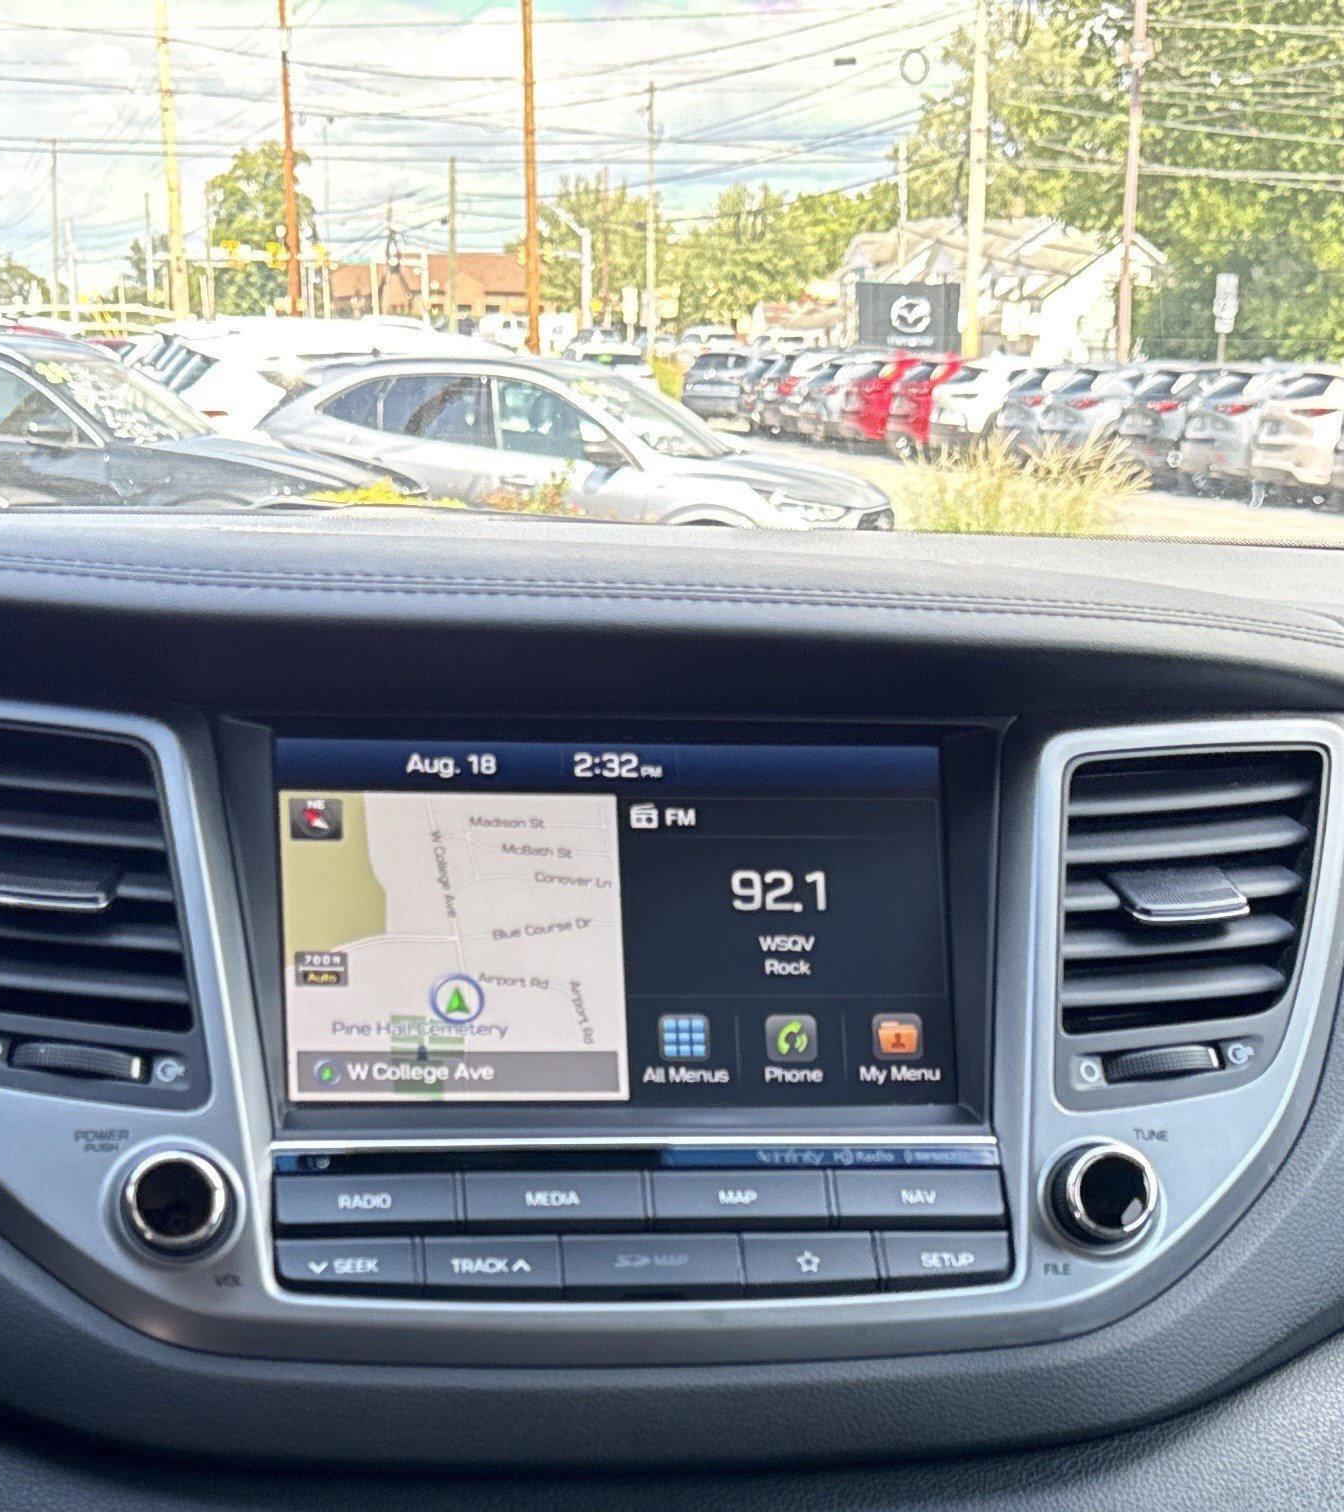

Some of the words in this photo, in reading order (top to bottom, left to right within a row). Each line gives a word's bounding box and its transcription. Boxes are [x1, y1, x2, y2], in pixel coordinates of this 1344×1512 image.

[406, 753, 460, 778] Aug.
[468, 754, 496, 773] 18
[573, 752, 639, 778] 2:32
[470, 816, 527, 829] Madison
[530, 816, 545, 829] St
[665, 808, 696, 827] FM
[557, 845, 573, 859] St
[433, 846, 451, 891] College
[444, 894, 457, 919] Ave
[731, 869, 827, 913] 92.1
[492, 926, 521, 941] Blue
[524, 919, 573, 936] Course
[759, 935, 815, 952] WSQV
[764, 958, 811, 976] Rock
[478, 972, 526, 988] Airport
[529, 977, 549, 990] Rd
[332, 1021, 372, 1036] Pine
[417, 1020, 508, 1042] Cemetery
[346, 1064, 369, 1081] W
[371, 1063, 449, 1082] College
[454, 1065, 494, 1081] Ave
[642, 1067, 666, 1083] All
[668, 1068, 730, 1083] Menus
[764, 1067, 824, 1083] Phone
[859, 1066, 886, 1084] My
[890, 1067, 941, 1082] Menu
[74, 1129, 130, 1142] POWER
[1134, 1128, 1168, 1142] TUNE
[338, 1194, 392, 1209] RADIO
[525, 1191, 581, 1207] MEDIA
[718, 1190, 758, 1205] MAP
[902, 1189, 937, 1204] NAV
[334, 1258, 379, 1275] SEEK
[452, 1259, 508, 1275] TRACK
[920, 1252, 975, 1269] SETUP
[1044, 1263, 1070, 1276] FILE
